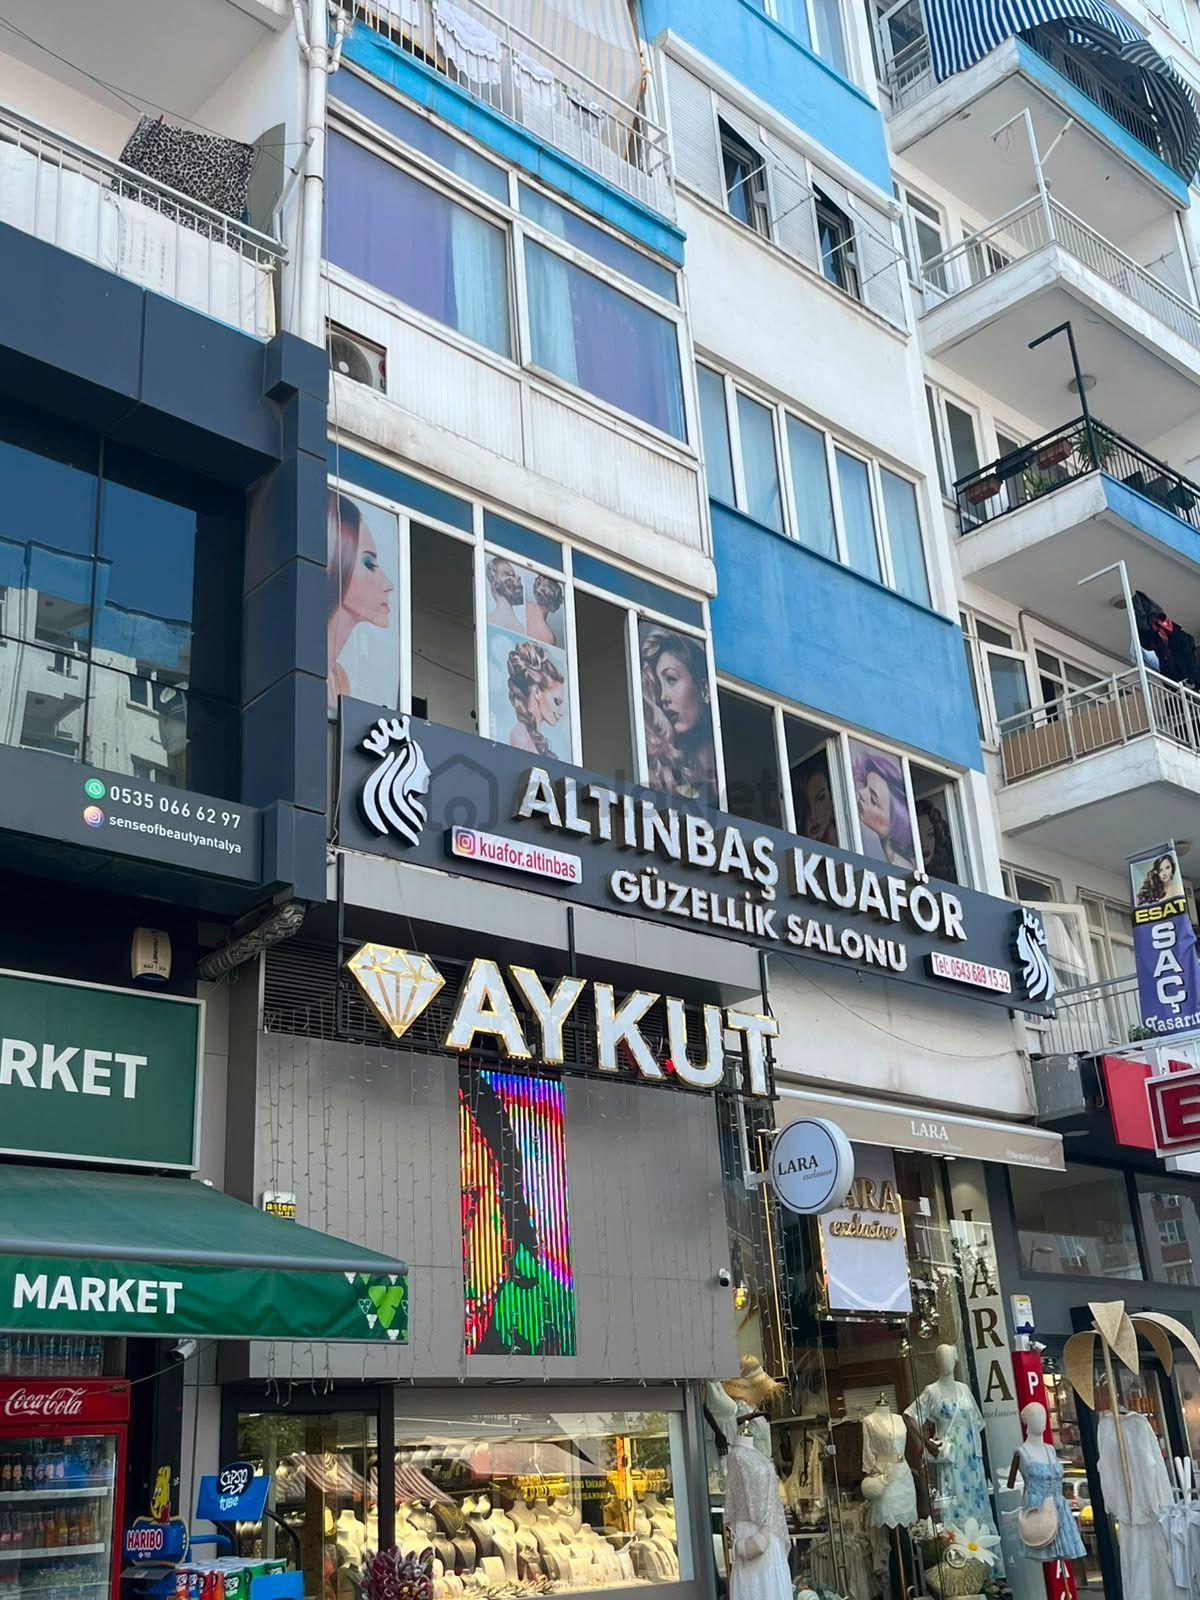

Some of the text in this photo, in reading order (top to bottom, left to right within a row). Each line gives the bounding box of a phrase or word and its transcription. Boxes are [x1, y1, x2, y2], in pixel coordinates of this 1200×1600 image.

[110, 786, 241, 828] 0535 066 62 97
[109, 816, 242, 854] senseofbeautyantalya
[517, 767, 967, 941] ALTINBAŞ KUAFÖR
[480, 837, 576, 878] kuafor.altinbas
[608, 867, 908, 972] GÜZELLİK SALONU
[1135, 899, 1186, 924] ESAT
[933, 954, 1010, 990] Tel: 0543 689 15 32
[1151, 921, 1187, 1014] SAÇ
[445, 957, 780, 1097] AYKUT
[0, 1038, 148, 1099] RKET
[911, 1121, 949, 1140] LARA
[778, 1155, 819, 1176] LARA
[841, 1177, 900, 1214] ARA
[830, 1213, 897, 1240] exclusive
[13, 1273, 183, 1314] MARKET
[126, 1528, 163, 1551] HARIBO
